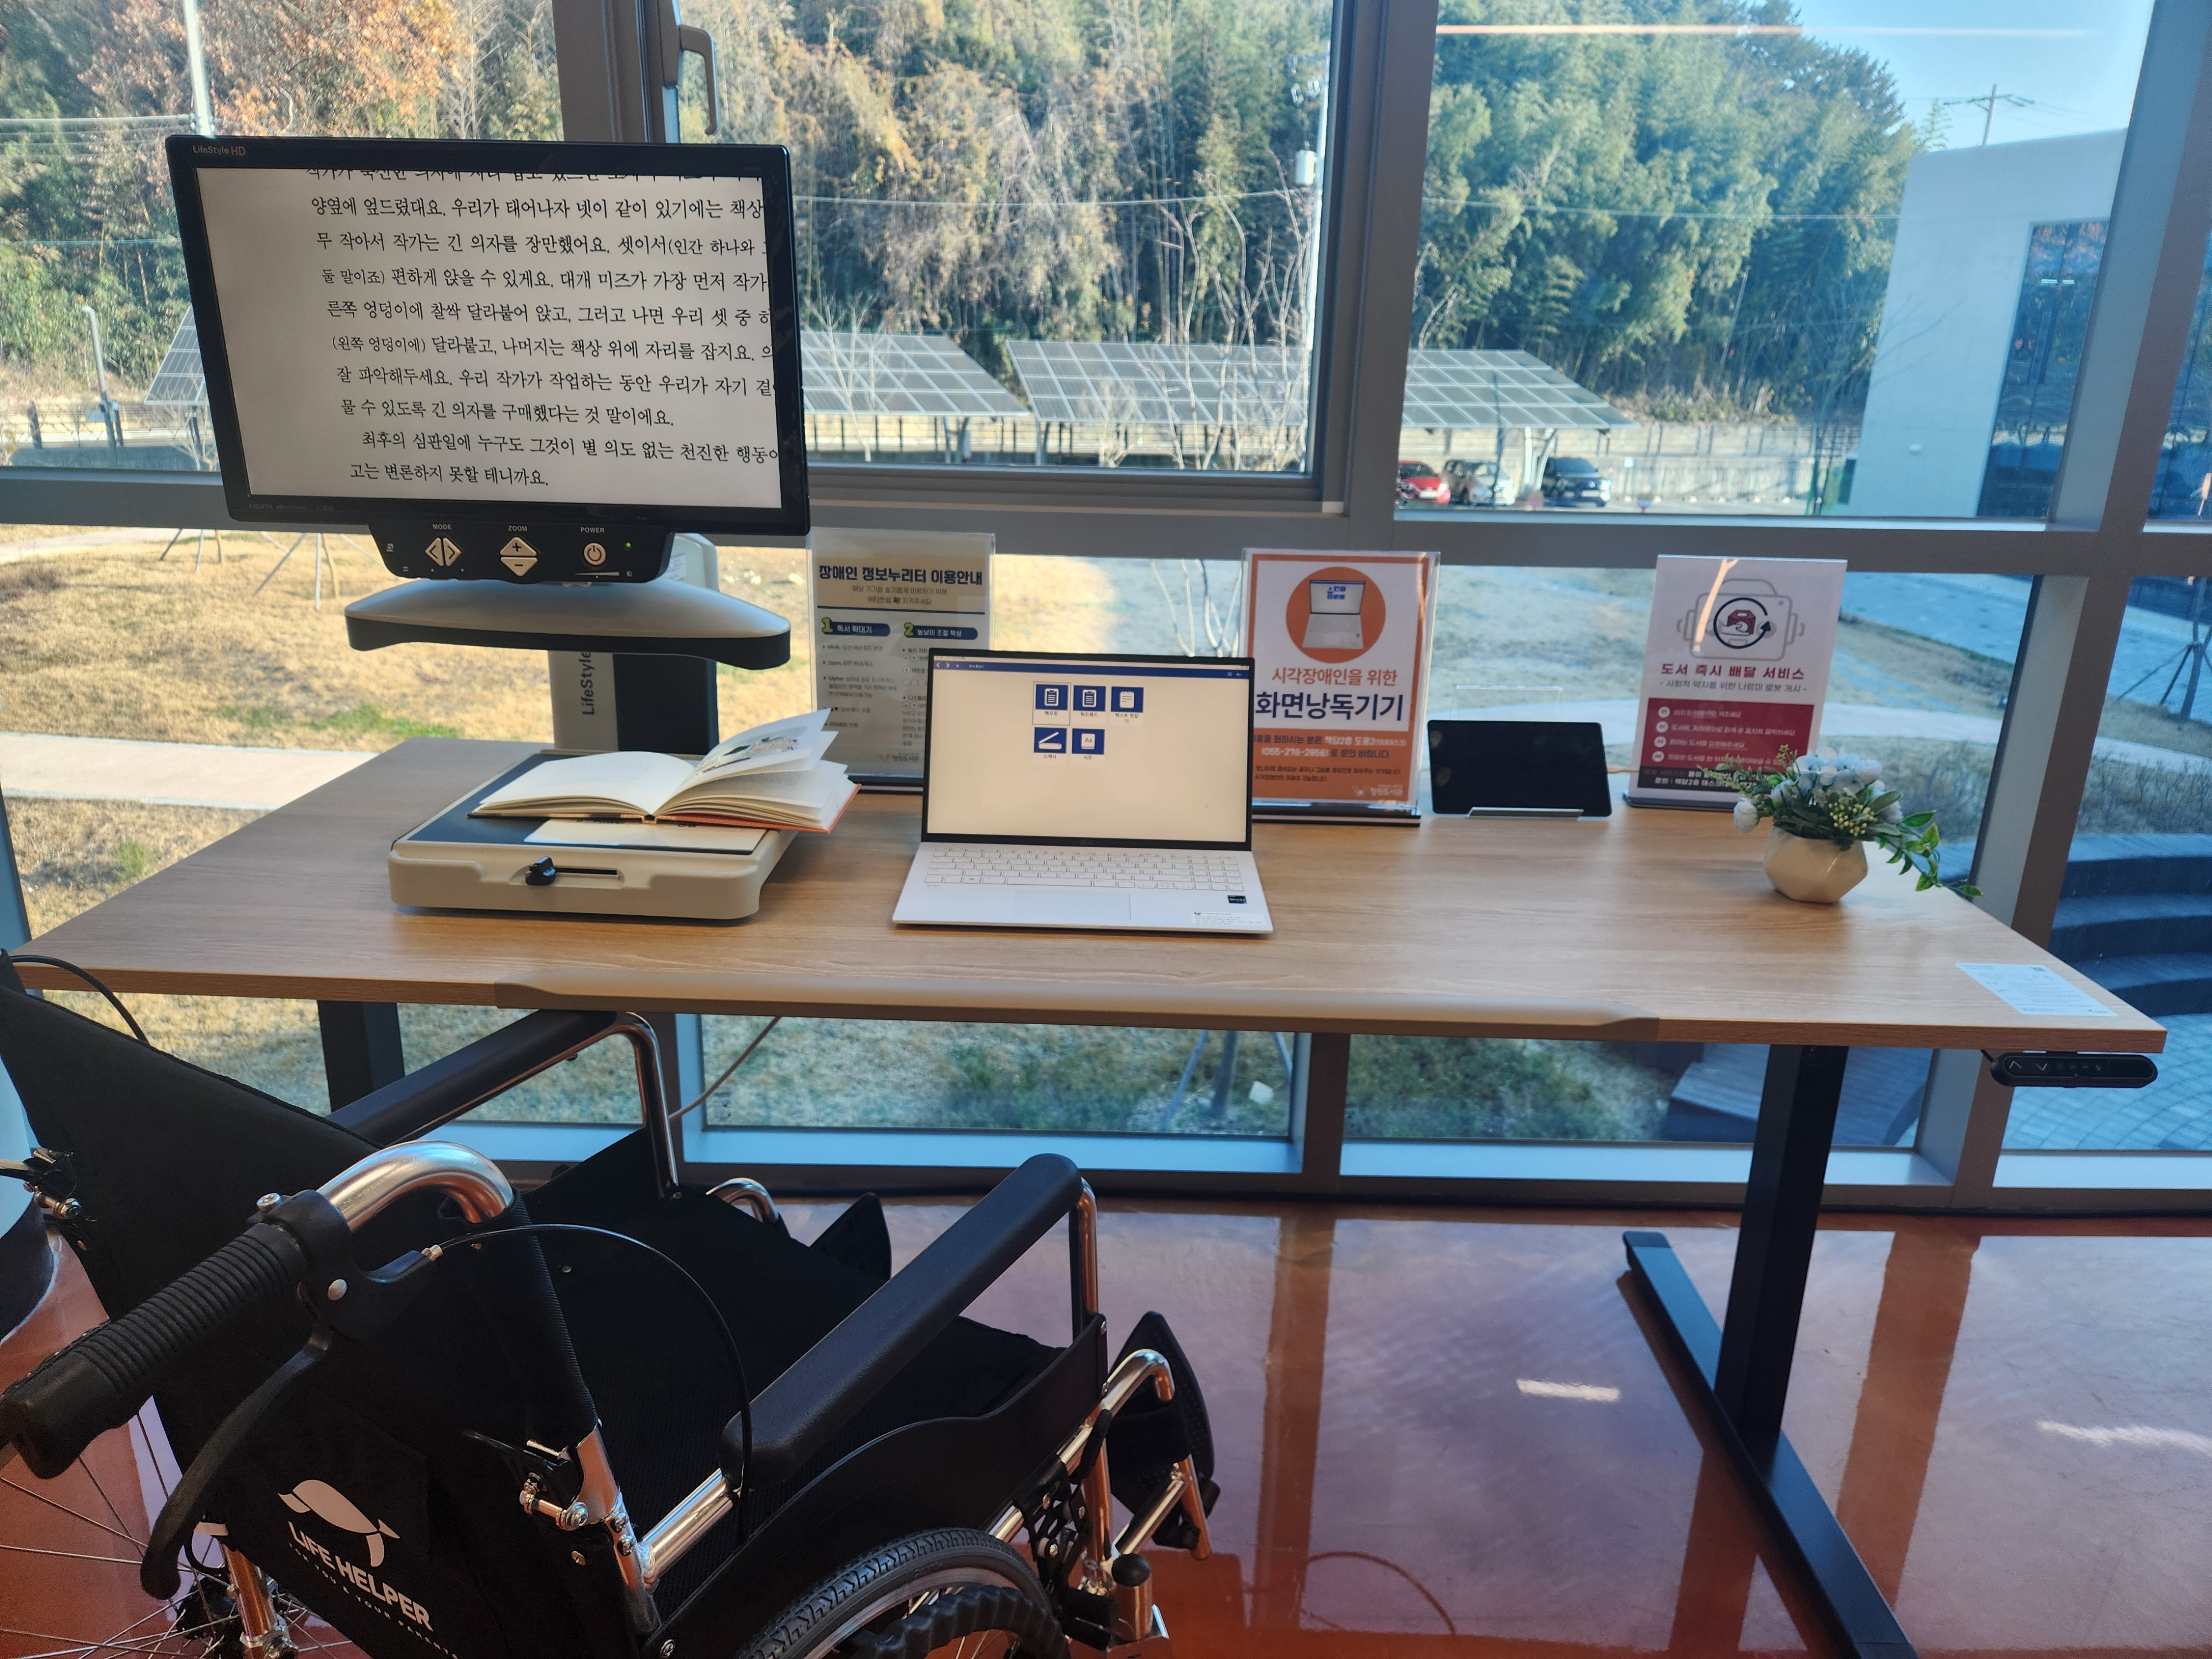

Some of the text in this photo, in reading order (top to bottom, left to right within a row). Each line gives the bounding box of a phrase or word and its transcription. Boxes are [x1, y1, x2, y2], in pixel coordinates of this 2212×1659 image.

[192, 145, 246, 155] LifeStyle HD
[311, 196, 762, 220] 양옆에 엎드렸대요. 우리가 태어나자 넷이 같이 있기에는 책상
[316, 232, 332, 250] 무
[340, 231, 385, 252] 작아서
[393, 232, 440, 252] 작가는
[447, 233, 463, 252] 긴
[471, 233, 518, 254] 의자를
[525, 234, 610, 255] 장만했어요.
[709, 238, 755, 257] 하나와
[321, 269, 336, 284] 둘
[340, 268, 385, 285] 말이죠)
[391, 267, 437, 287] 편하게
[444, 268, 475, 287] 앉을
[480, 269, 497, 288] 수
[559, 269, 591, 290] 대개
[597, 270, 648, 290] 미즈가
[653, 270, 687, 291] 가장
[692, 271, 724, 292] 먼저
[732, 272, 767, 293] 작가
[327, 300, 358, 319] 른쪽
[363, 300, 424, 321] 엉덩이에
[431, 301, 462, 321] 찰싹
[466, 302, 528, 323] 달라붙어
[535, 304, 571, 324] 앉고,
[577, 305, 627, 325] 그러고
[632, 305, 665, 325] 나면
[671, 306, 703, 327] 우리
[711, 307, 728, 327] 셋
[734, 309, 752, 327] 중
[332, 335, 364, 352] (왼쪽
[368, 336, 426, 353] 엉덩이에)
[431, 335, 497, 356] 달라붙고,
[502, 337, 565, 357] 나머지는
[570, 338, 602, 358] 책상
[608, 339, 638, 359] 위에
[645, 340, 695, 360] 자리를
[700, 342, 755, 362] 잡지요.
[337, 366, 352, 383] 잘
[358, 366, 452, 387] 파악해두세요.
[458, 369, 488, 388] 우리
[496, 369, 543, 390] 작가가
[549, 371, 613, 392] 작업하는
[618, 374, 652, 393] 동안
[658, 374, 709, 395] 우리가
[714, 377, 747, 397] 자기
[341, 399, 674, 427] 물 수 있도록 긴 의자를 구매했다는 것 말이에요.
[362, 430, 405, 450] 최후의
[412, 432, 471, 452] 심판일에
[477, 434, 524, 453] 누구도
[530, 436, 575, 456] 그것이
[582, 438, 598, 456] 별
[604, 439, 637, 458] 의도
[641, 441, 674, 460] 없는
[680, 442, 729, 462] 천진한
[350, 462, 549, 486] 고는 변론하지 못할 테니까요.
[819, 565, 983, 585] 장애인 정보누리터 이용안내
[852, 625, 873, 633] 확대기
[578, 652, 595, 715] LifeStyle
[1271, 667, 1398, 686] 시각장애인을 위한
[1661, 663, 1805, 680] 도서 즉시 배달 서비스
[1255, 691, 1404, 721] 화면낭독기기
[1274, 735, 1304, 744] 원하시는
[288, 1521, 434, 1632] LIFE HELPER
